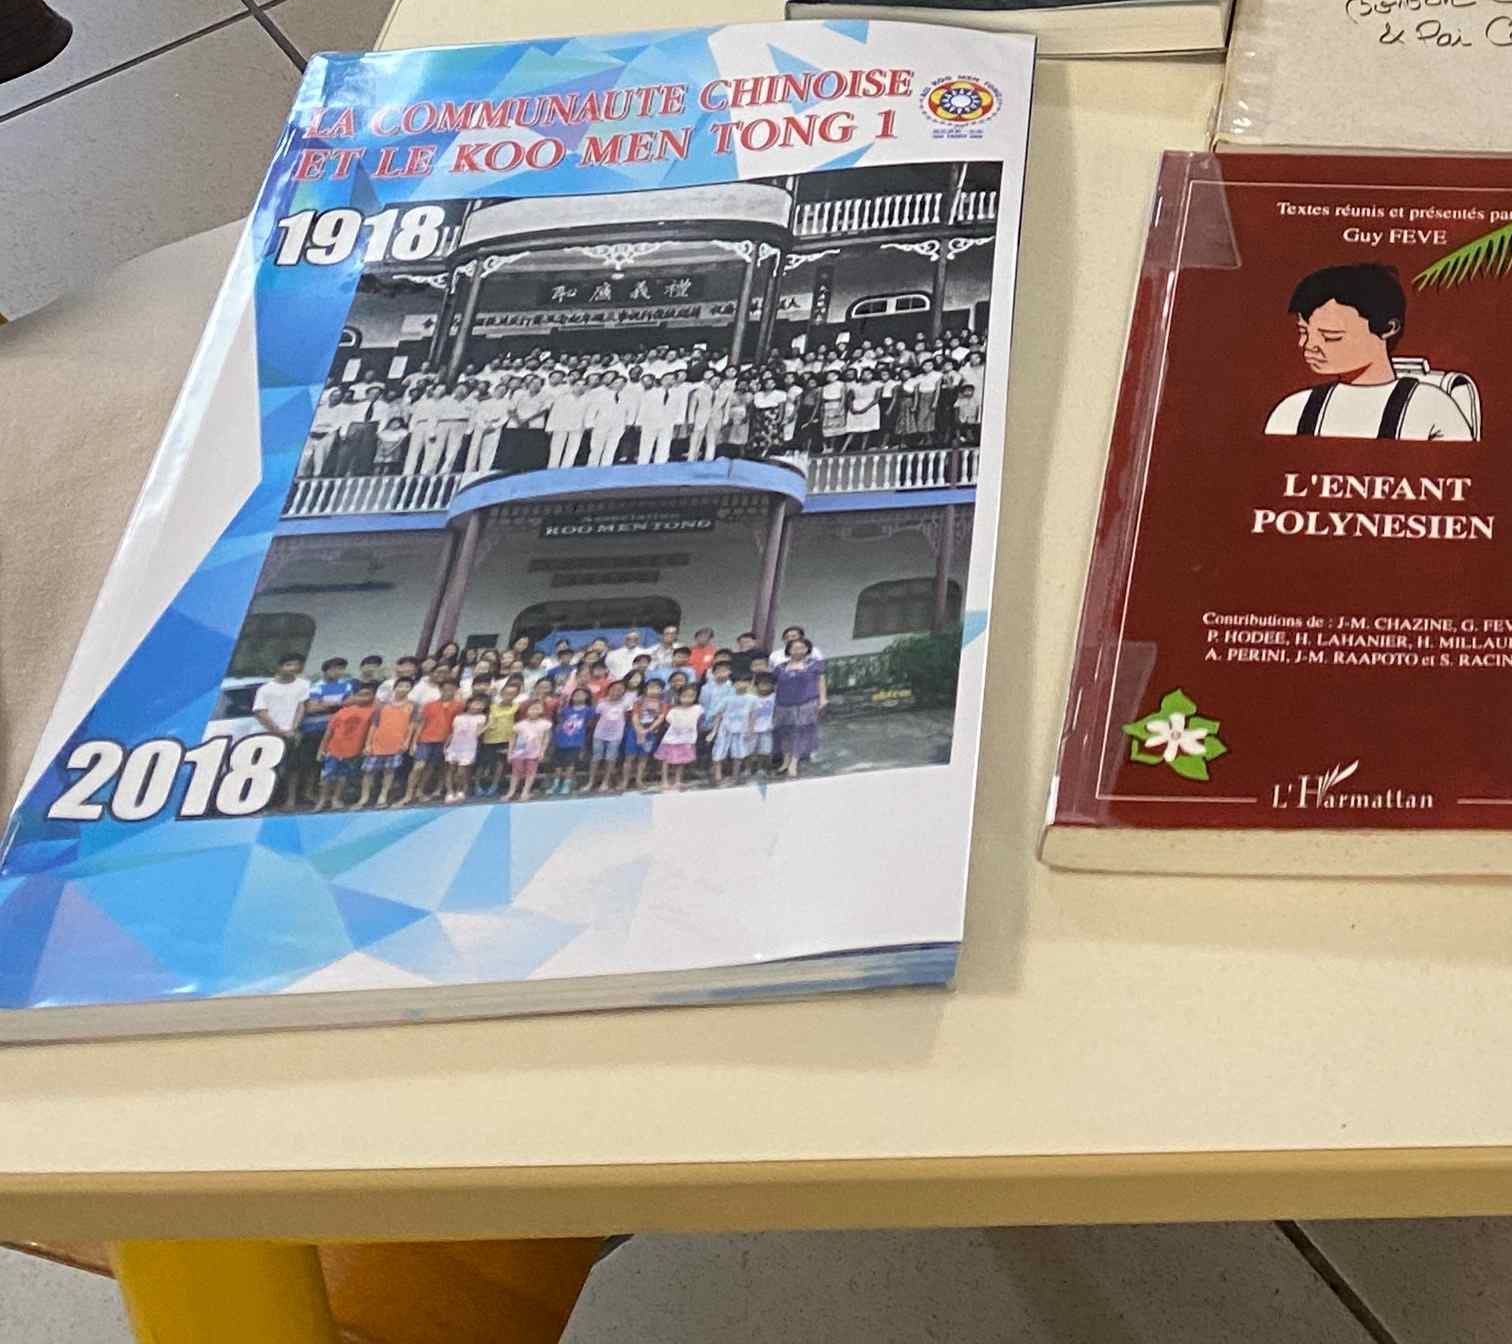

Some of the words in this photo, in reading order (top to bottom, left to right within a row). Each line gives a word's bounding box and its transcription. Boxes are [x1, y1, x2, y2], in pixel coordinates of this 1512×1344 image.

[304, 106, 362, 141] LA
[370, 81, 688, 135] COMMUNAUTE
[698, 67, 915, 109] CHINOISE
[294, 146, 359, 182] ET
[371, 143, 435, 179] LE
[451, 136, 566, 175] KOO
[578, 123, 690, 169] MEN
[711, 113, 858, 156] TONG
[875, 109, 898, 142] 1
[1277, 202, 1330, 219] Textes
[1335, 202, 1386, 219] réunis
[1389, 206, 1406, 220] et
[1409, 204, 1487, 223] présentés
[273, 204, 448, 268] 1918
[1343, 226, 1385, 249] Guy
[1390, 227, 1448, 246] FEVE
[1282, 473, 1473, 503] L'ENFANT
[1251, 509, 1495, 541] POLYNESIEN
[1202, 612, 1303, 628] Contributions
[1306, 615, 1324, 629] de
[1337, 616, 1370, 630] J-M.
[1374, 616, 1457, 633] CHAZINE,
[1460, 619, 1479, 632] G.
[1207, 630, 1222, 644] P.
[1224, 630, 1290, 646] HODEE,
[1295, 632, 1312, 646] H.
[1317, 632, 1413, 649] LAHANIER,
[1417, 635, 1434, 649] H.
[1204, 646, 1222, 662] A.
[1227, 647, 1291, 663] PERINI,
[1294, 649, 1329, 664] J-M.
[1333, 651, 1419, 666] RAAPOTO
[1421, 654, 1436, 667] et
[1439, 653, 1457, 667] S.
[45, 733, 288, 824] 2018
